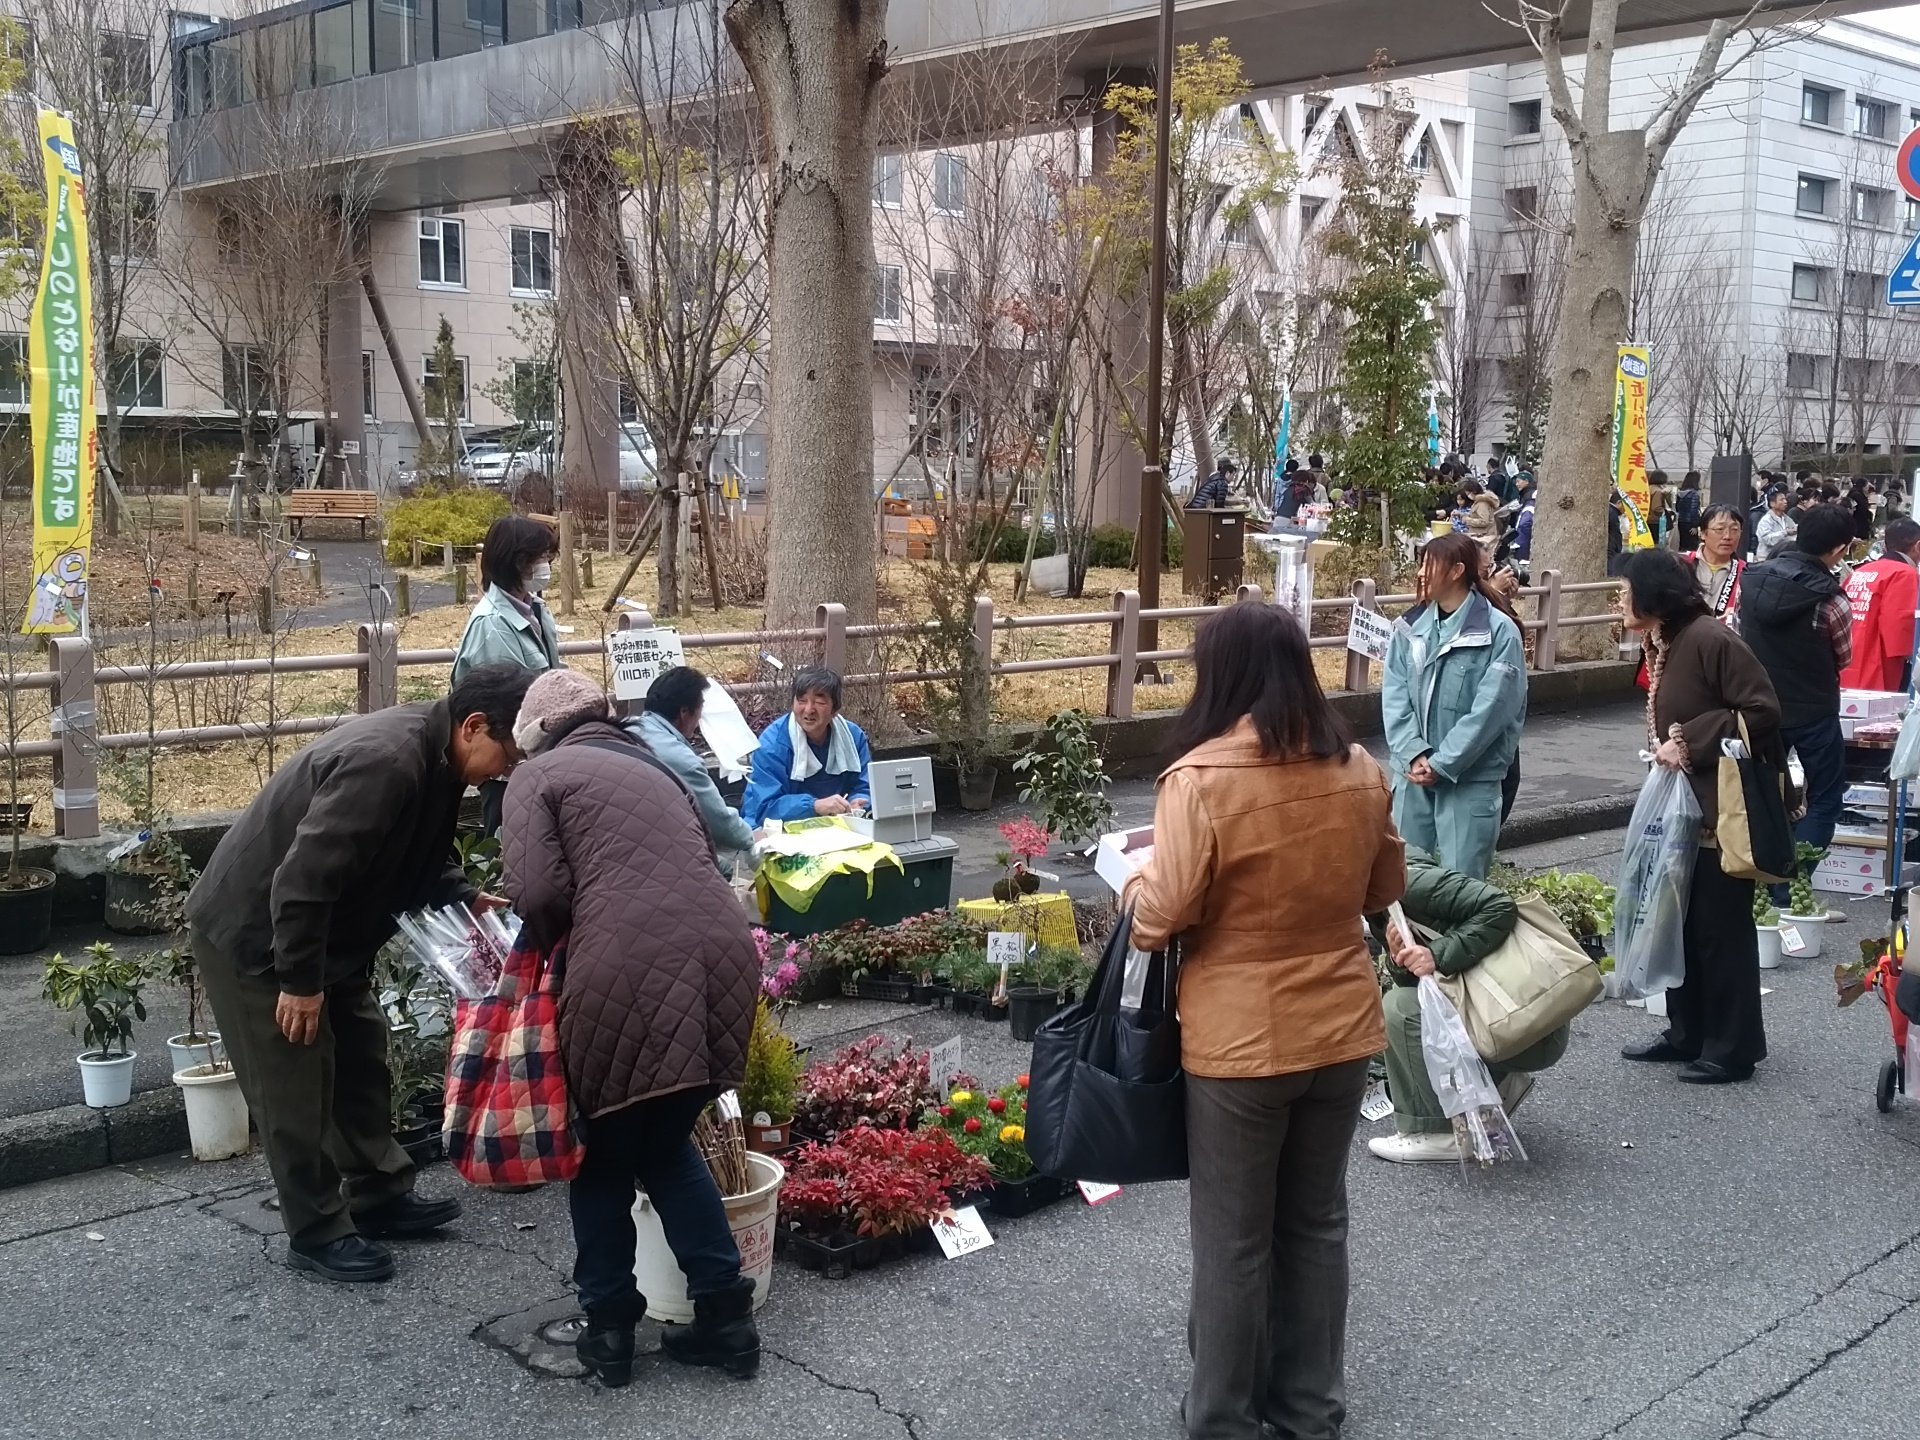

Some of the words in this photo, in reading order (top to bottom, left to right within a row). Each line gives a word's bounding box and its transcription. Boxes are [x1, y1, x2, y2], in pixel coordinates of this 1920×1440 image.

[612, 639, 659, 652] あゆみ野農協
[614, 650, 680, 664] 安行園芸センター
[1362, 1100, 1390, 1118] ¥350
[952, 1236, 981, 1253] ¥300
